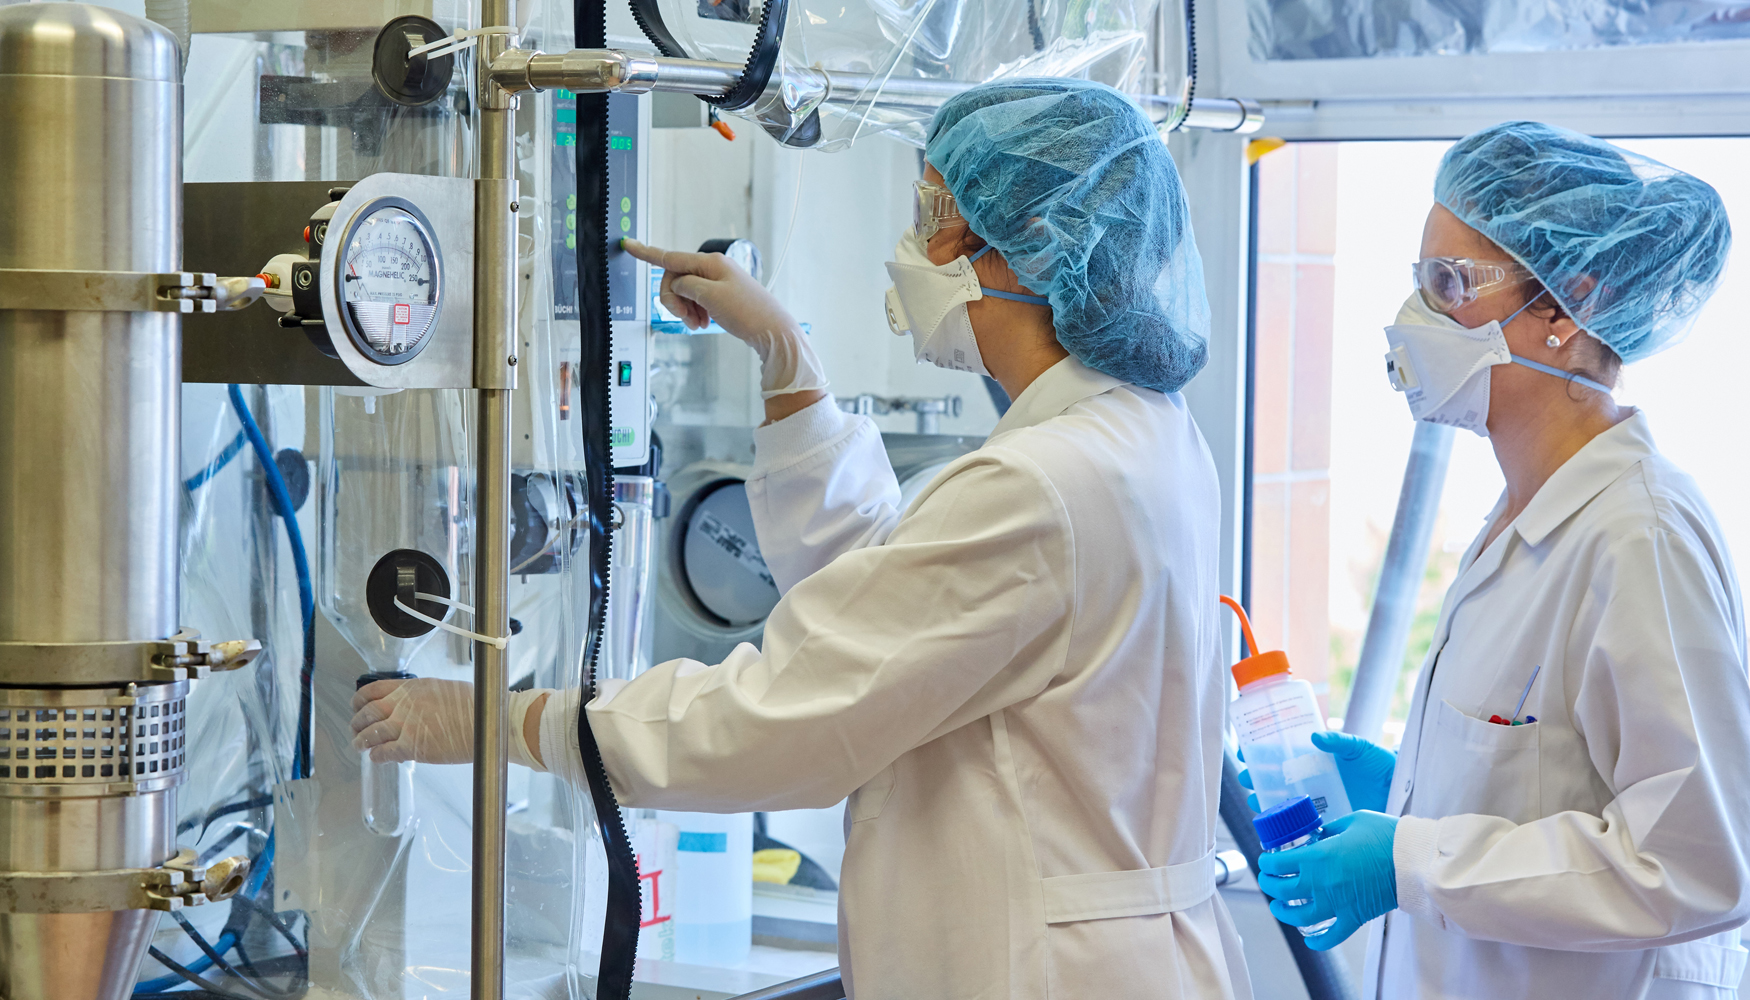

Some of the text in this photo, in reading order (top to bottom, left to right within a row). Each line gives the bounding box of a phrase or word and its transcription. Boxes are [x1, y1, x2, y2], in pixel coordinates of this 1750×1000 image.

[612, 138, 632, 150] 005
[368, 270, 404, 279] MAGNEHELIC
[554, 304, 573, 314] BÜCHI
[616, 306, 633, 314] B-191
